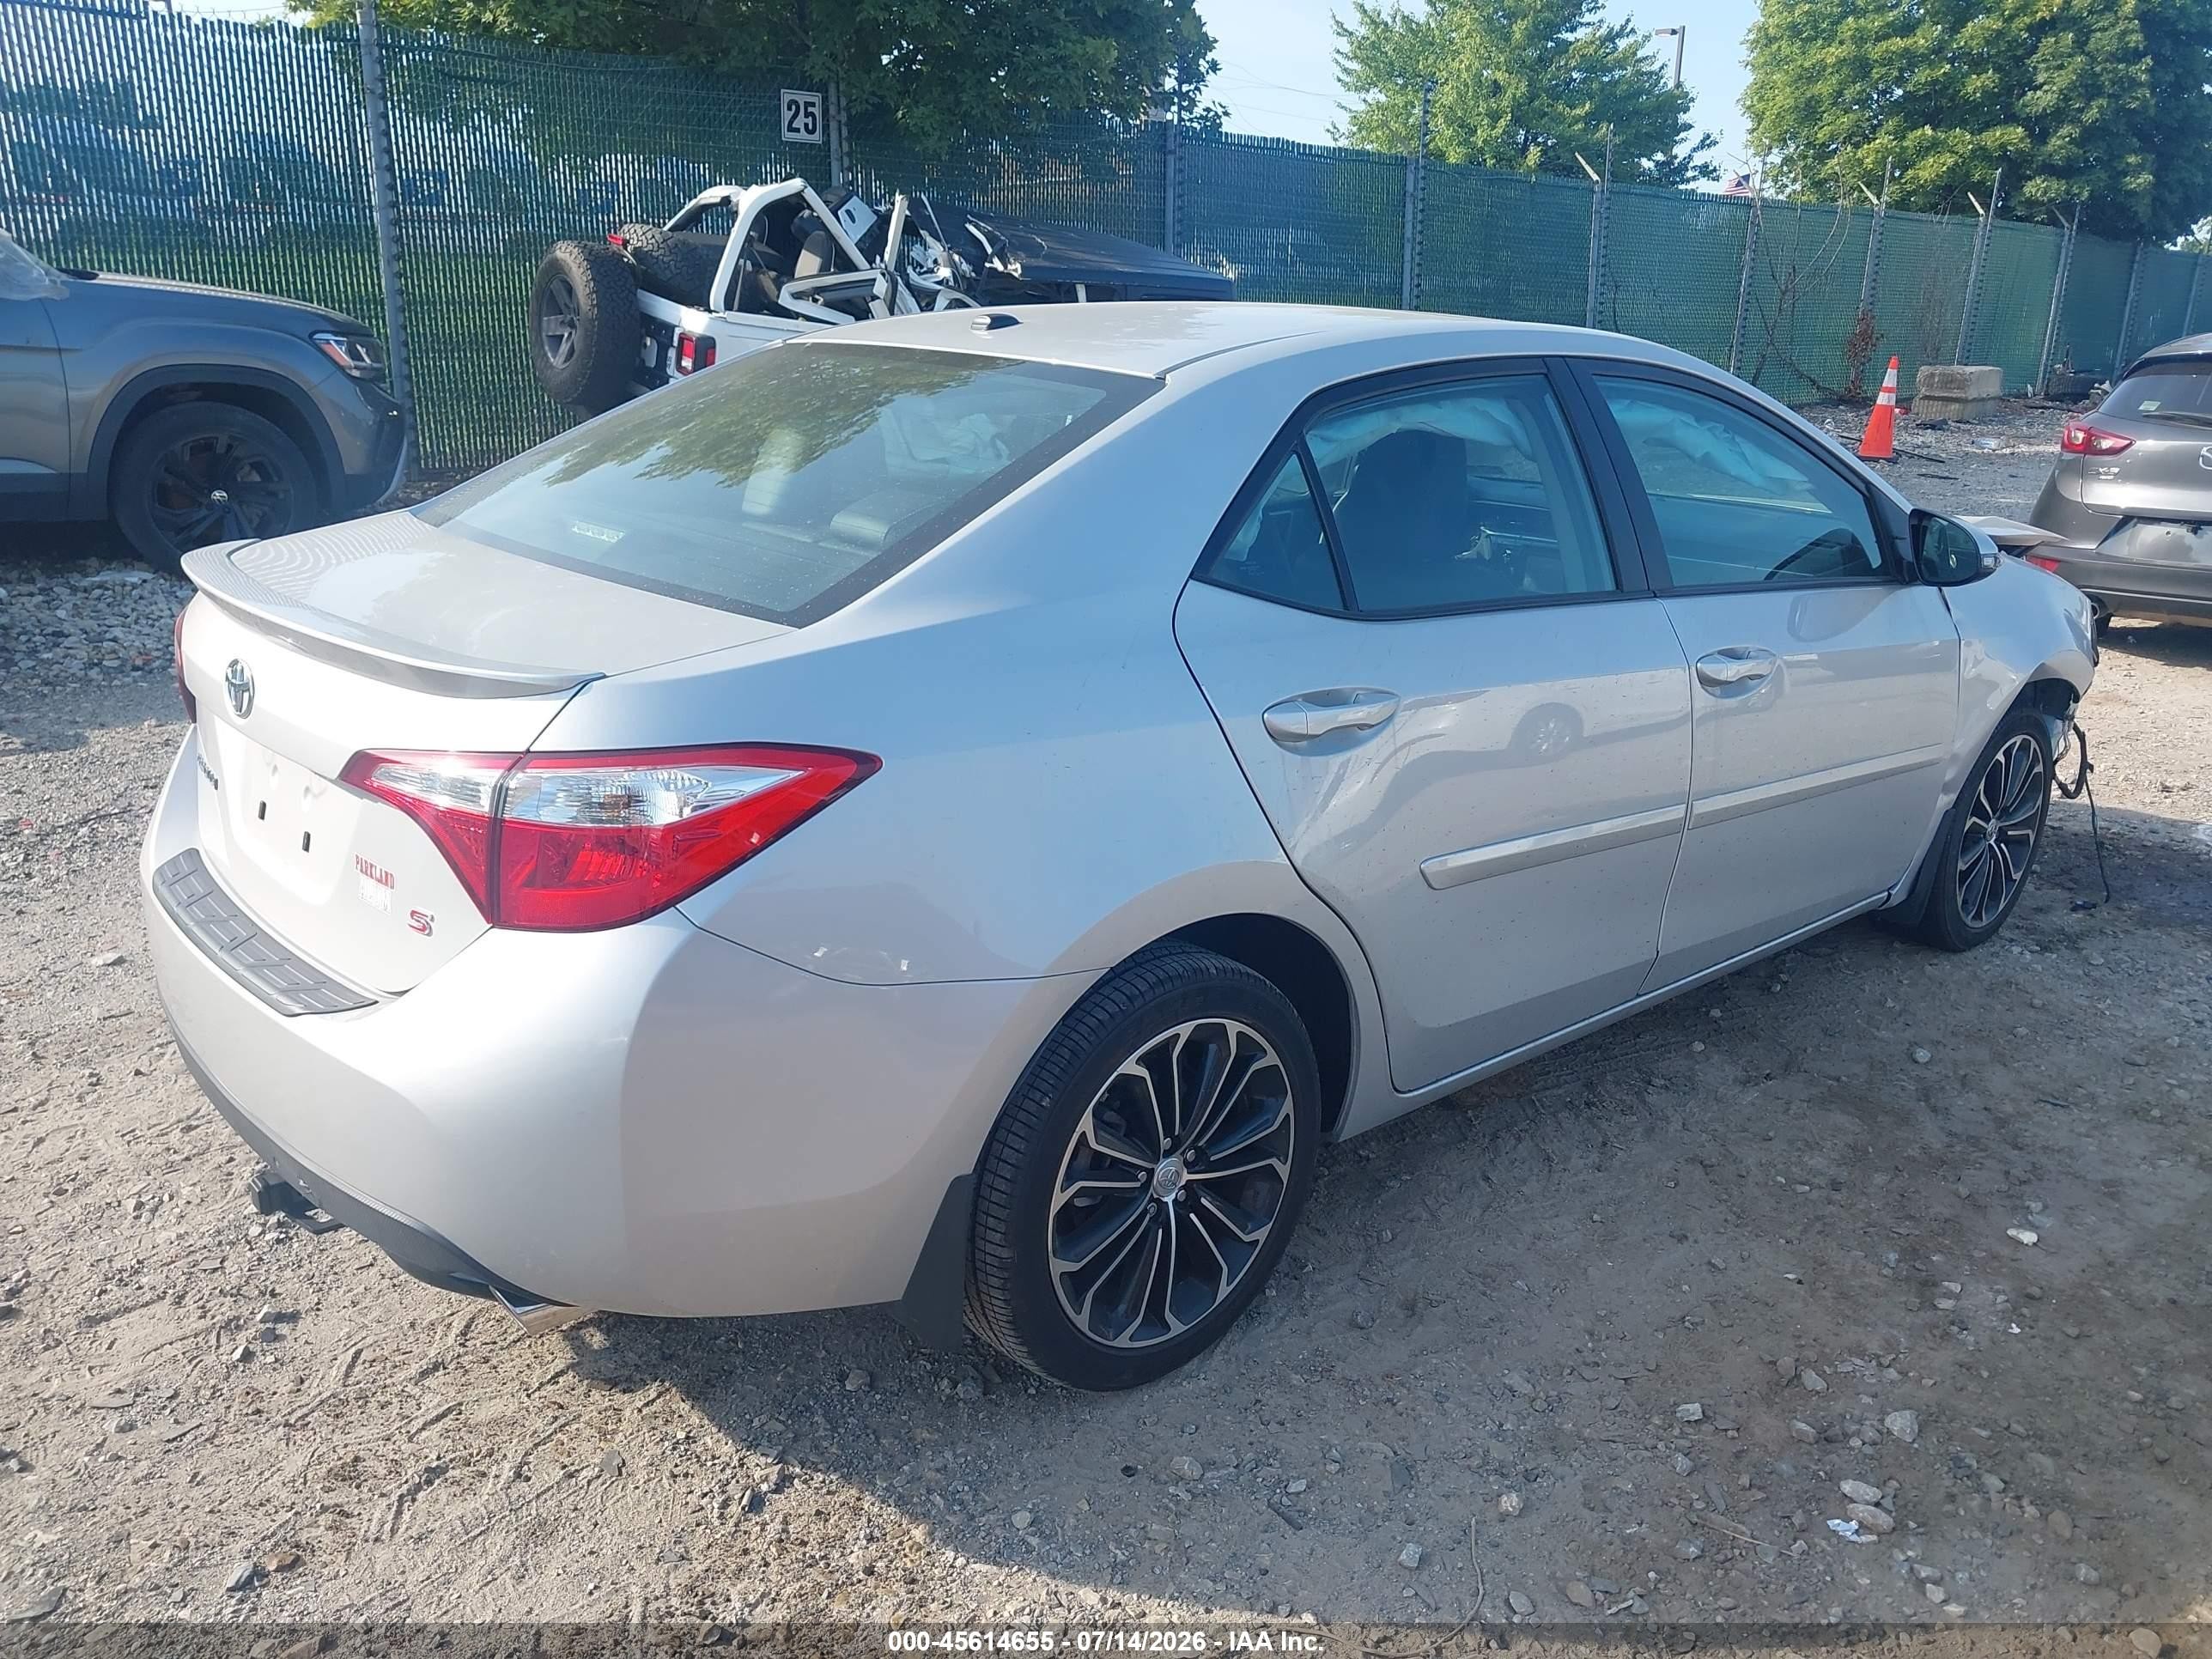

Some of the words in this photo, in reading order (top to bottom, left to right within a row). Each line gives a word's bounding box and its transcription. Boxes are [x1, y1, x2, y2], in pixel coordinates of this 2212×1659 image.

[787, 99, 817, 135] 25
[355, 854, 395, 890] PARKLAND
[408, 909, 434, 937] S
